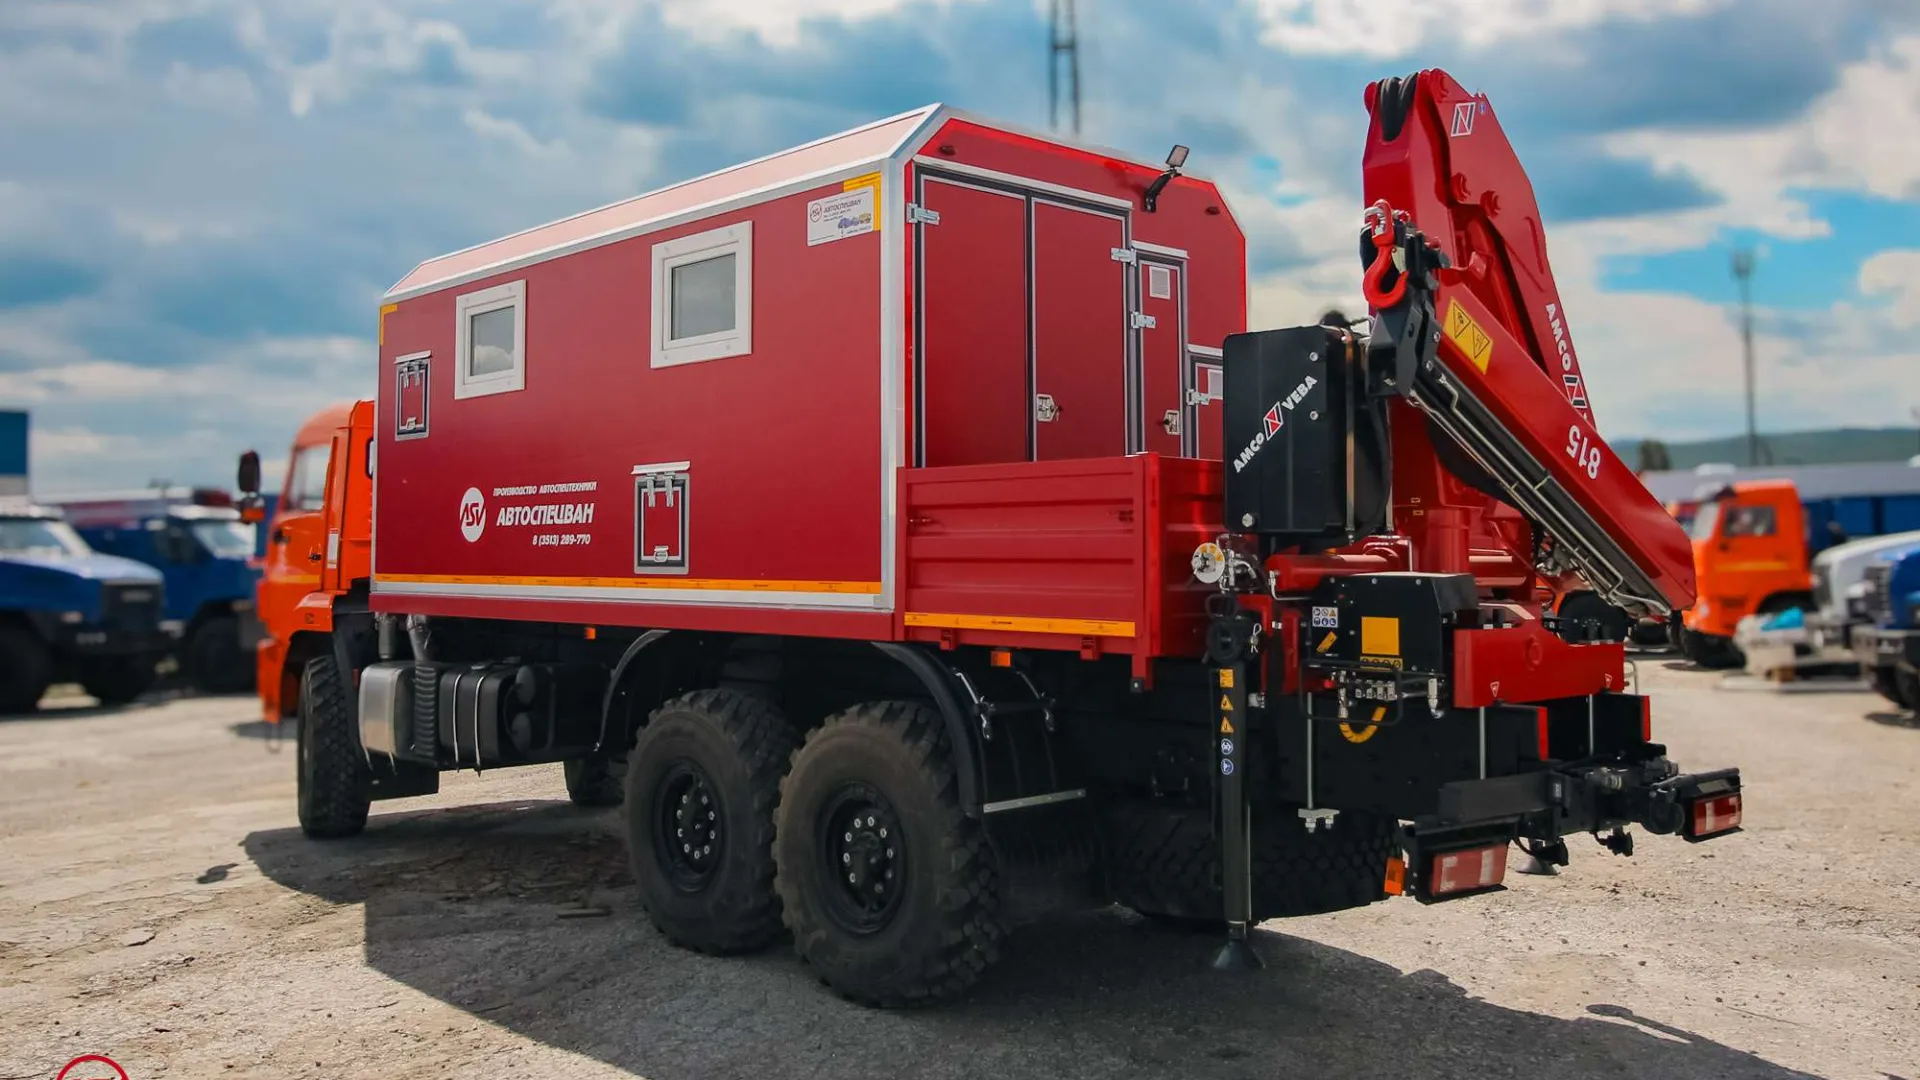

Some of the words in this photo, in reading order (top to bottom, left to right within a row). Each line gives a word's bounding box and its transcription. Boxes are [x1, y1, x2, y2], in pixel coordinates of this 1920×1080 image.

[1546, 303, 1571, 371] AMCO
[1233, 432, 1264, 473] AMCO
[1281, 375, 1318, 411] VEBA
[1566, 424, 1601, 480] 815
[493, 486, 537, 497] ПРОИЗВОДСТВО
[539, 481, 597, 494] АВТОСПЕЦТЕХНИКИ
[461, 503, 486, 527] ASV
[496, 503, 595, 526] АВТОСПЕЦВАН
[532, 534, 538, 545] 8
[538, 534, 559, 547] (3513)
[560, 533, 591, 545] 289-770
